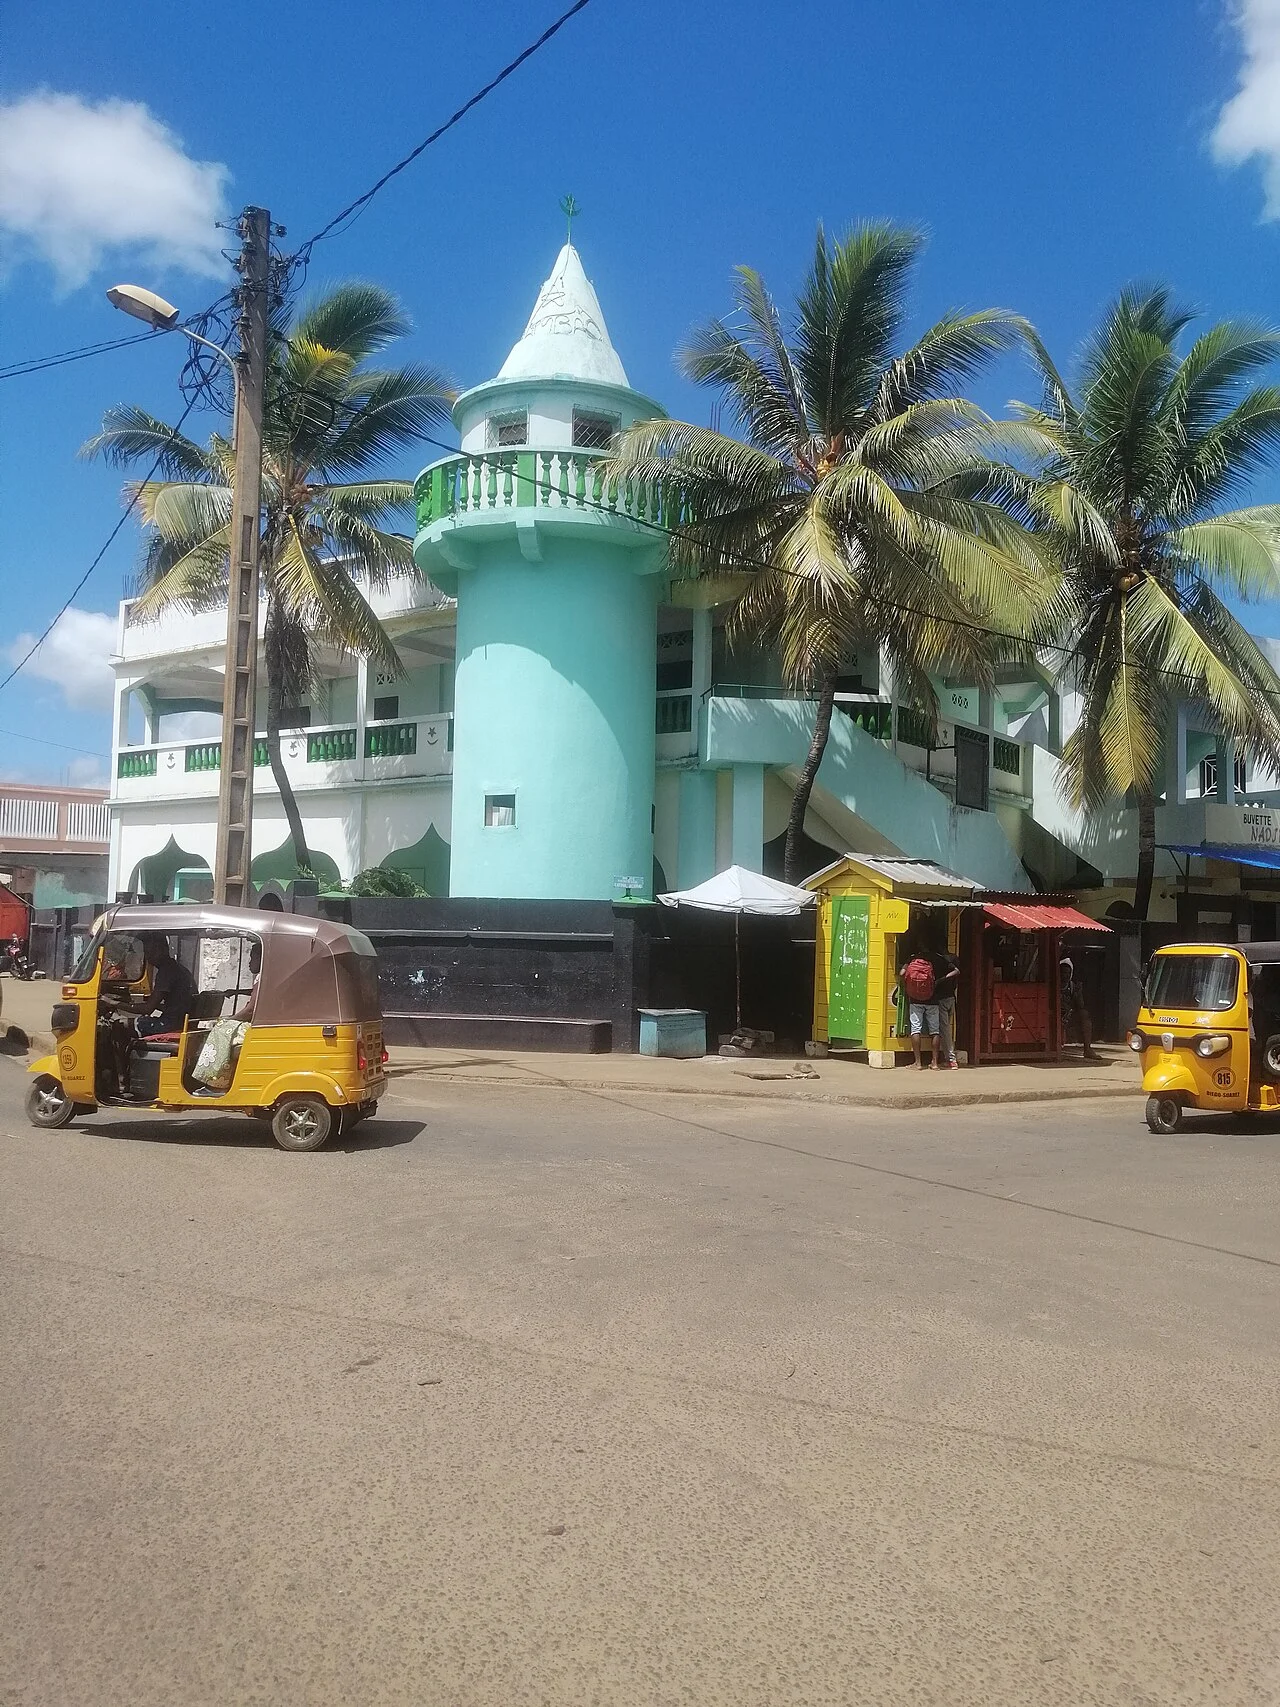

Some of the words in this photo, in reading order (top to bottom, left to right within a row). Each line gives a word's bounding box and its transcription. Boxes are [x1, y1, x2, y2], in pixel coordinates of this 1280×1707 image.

[1243, 813, 1272, 826] BUVETTE
[1251, 825, 1280, 843] NADJ
[1217, 1072, 1231, 1085] 815
